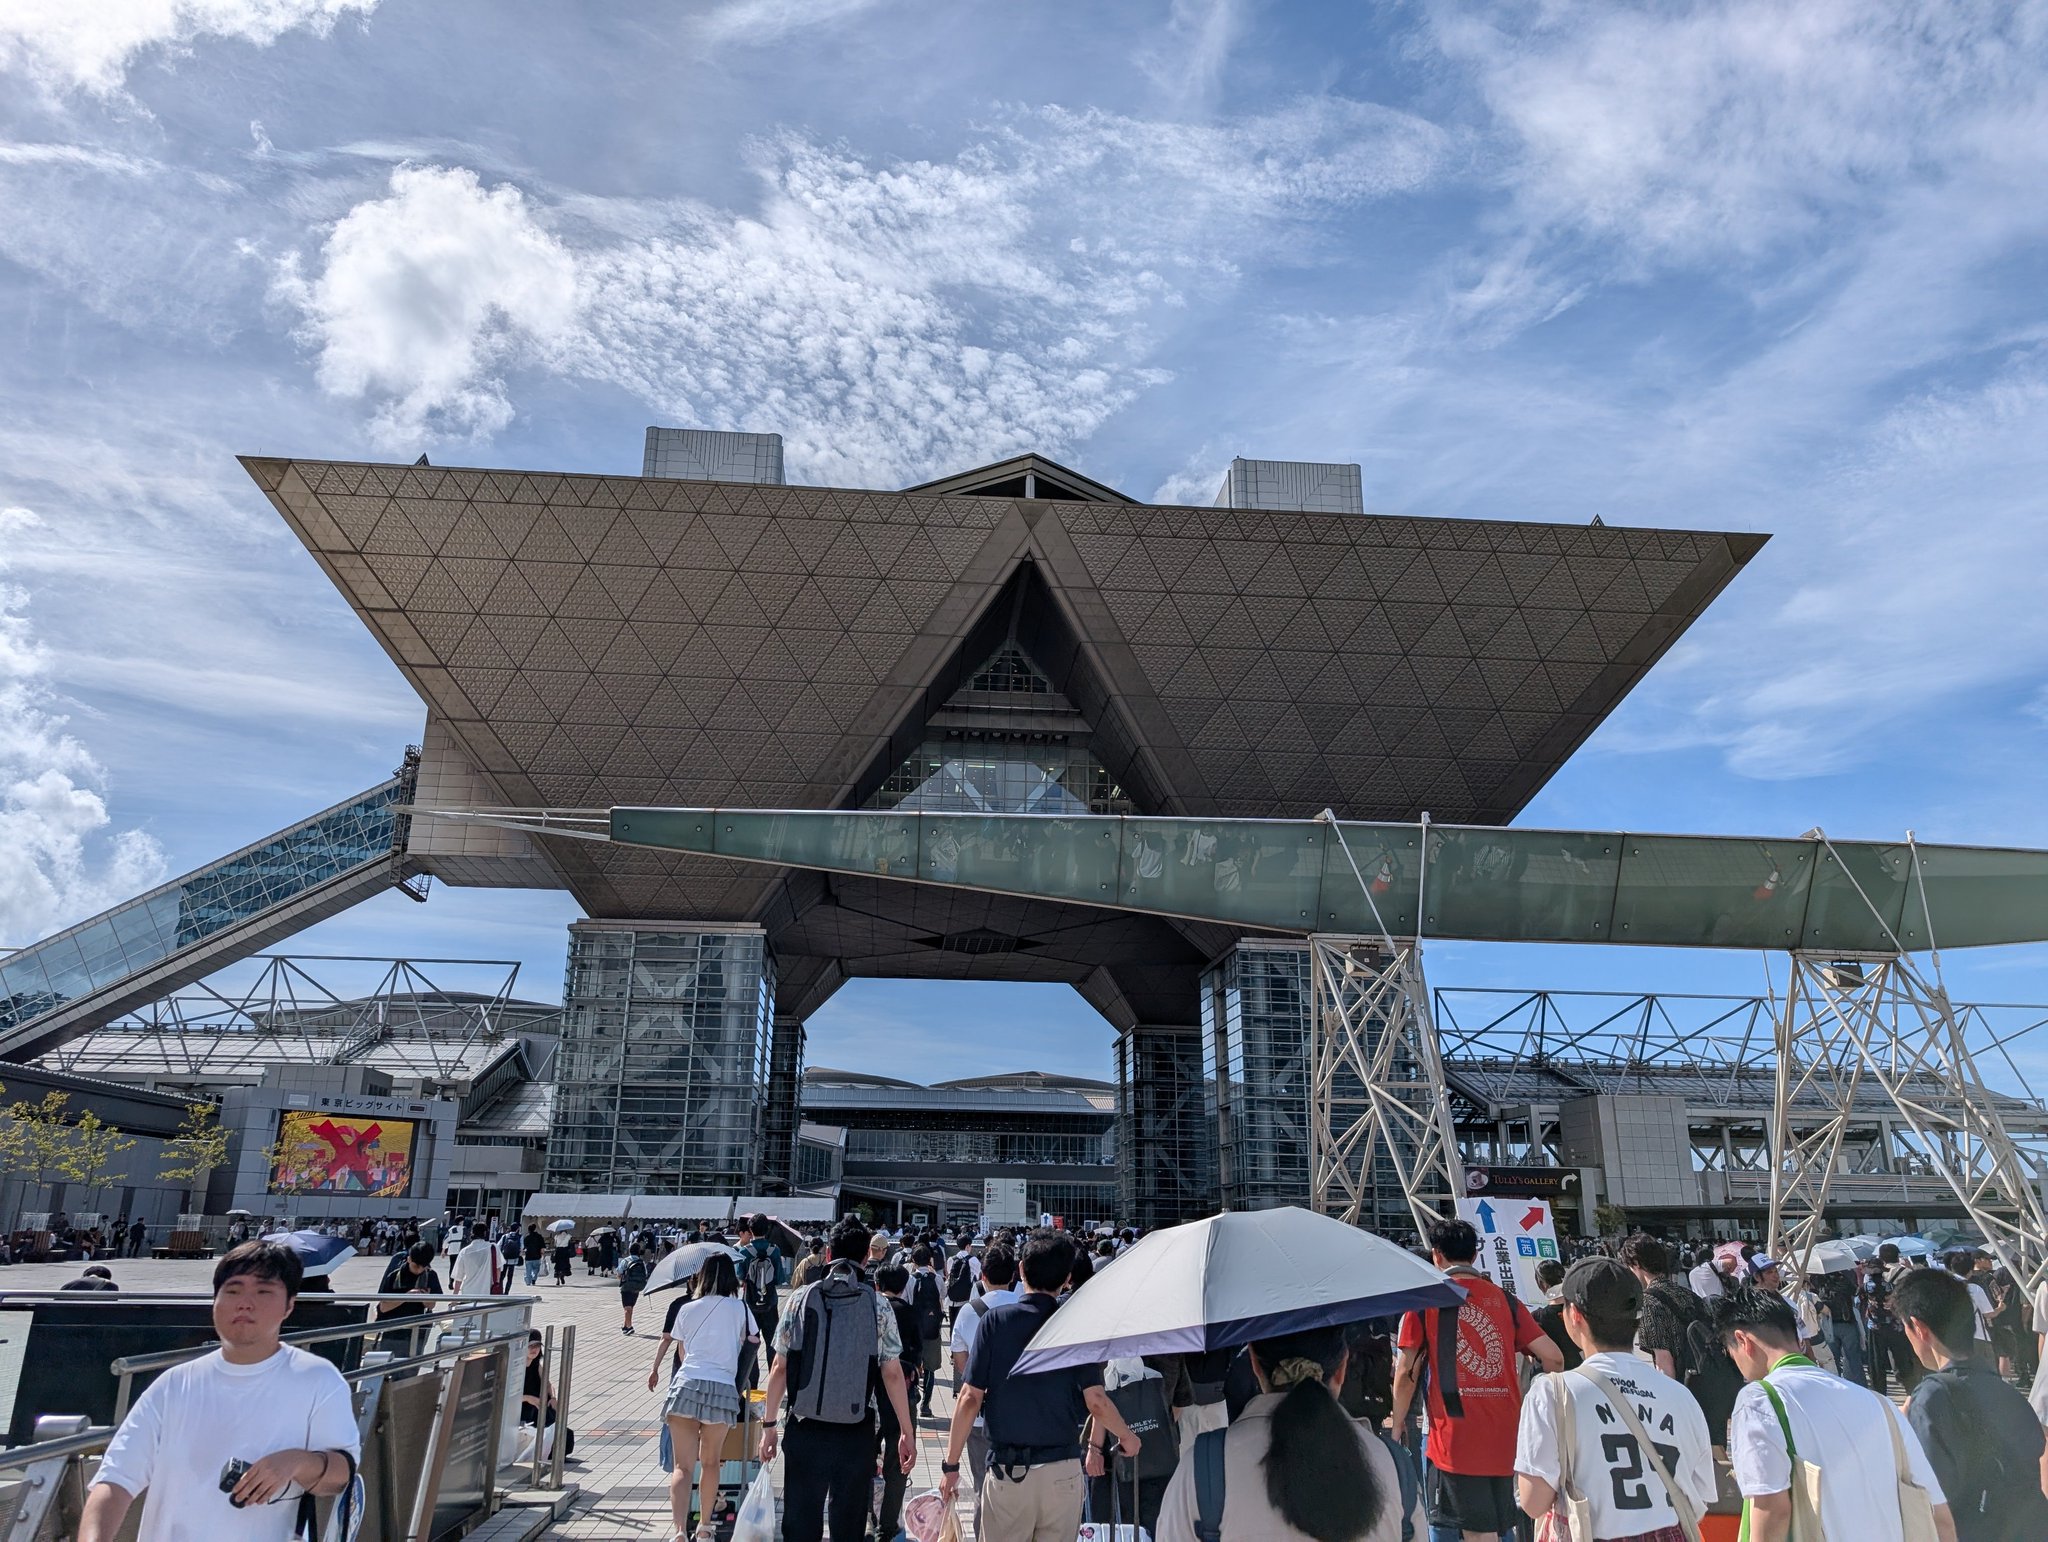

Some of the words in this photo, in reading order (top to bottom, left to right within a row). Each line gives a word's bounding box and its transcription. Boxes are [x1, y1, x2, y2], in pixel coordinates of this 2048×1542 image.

[320, 1097, 402, 1111] 東京ビッグサイト
[1493, 1175, 1523, 1185] TULLY'S
[1524, 1177, 1558, 1185] GALLERY
[1521, 1244, 1533, 1255] 西
[1542, 1245, 1553, 1257] 南
[1493, 1236, 1517, 1294] 企業出展
[1610, 1377, 1638, 1389] CHOOL
[1595, 1403, 1674, 1435] NNA
[1132, 1423, 1159, 1433] VIDSON
